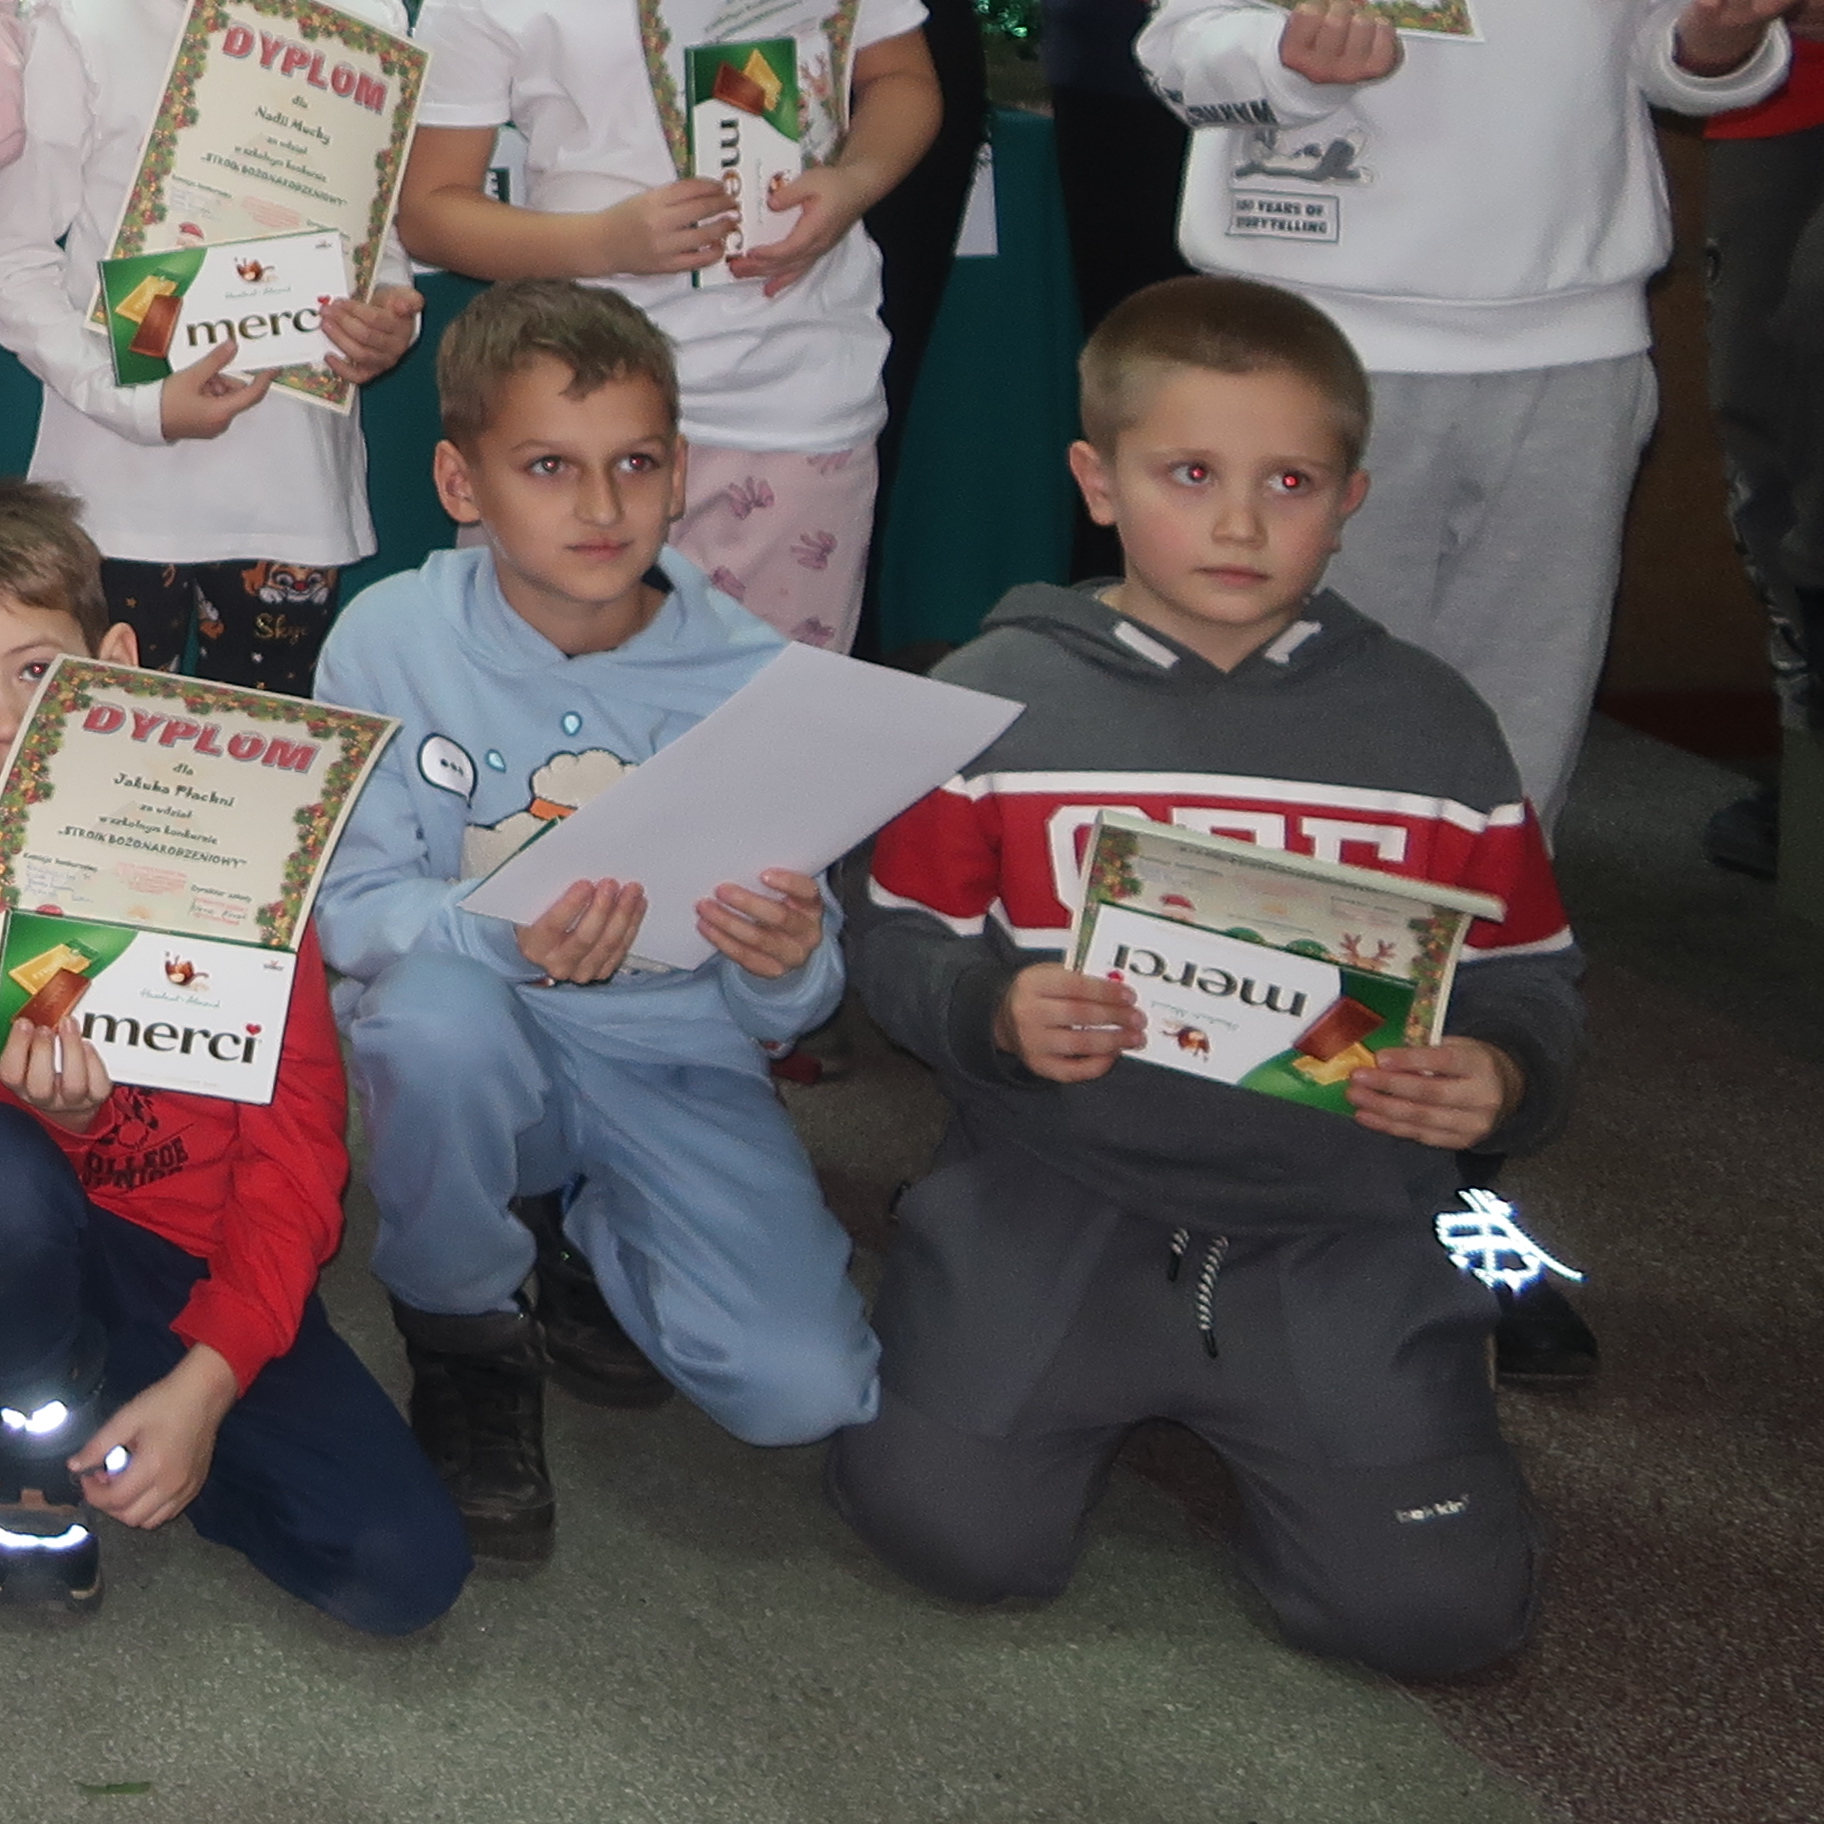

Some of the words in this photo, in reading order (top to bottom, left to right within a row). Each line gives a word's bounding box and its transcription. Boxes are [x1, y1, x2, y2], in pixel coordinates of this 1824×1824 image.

[222, 21, 389, 115] DYPLOM
[186, 307, 320, 346] merc
[83, 700, 321, 774] DYPLOM
[114, 773, 171, 795] Jakuba
[173, 762, 195, 776] dla
[1107, 944, 1309, 1019] merci
[83, 1011, 261, 1065] merci
